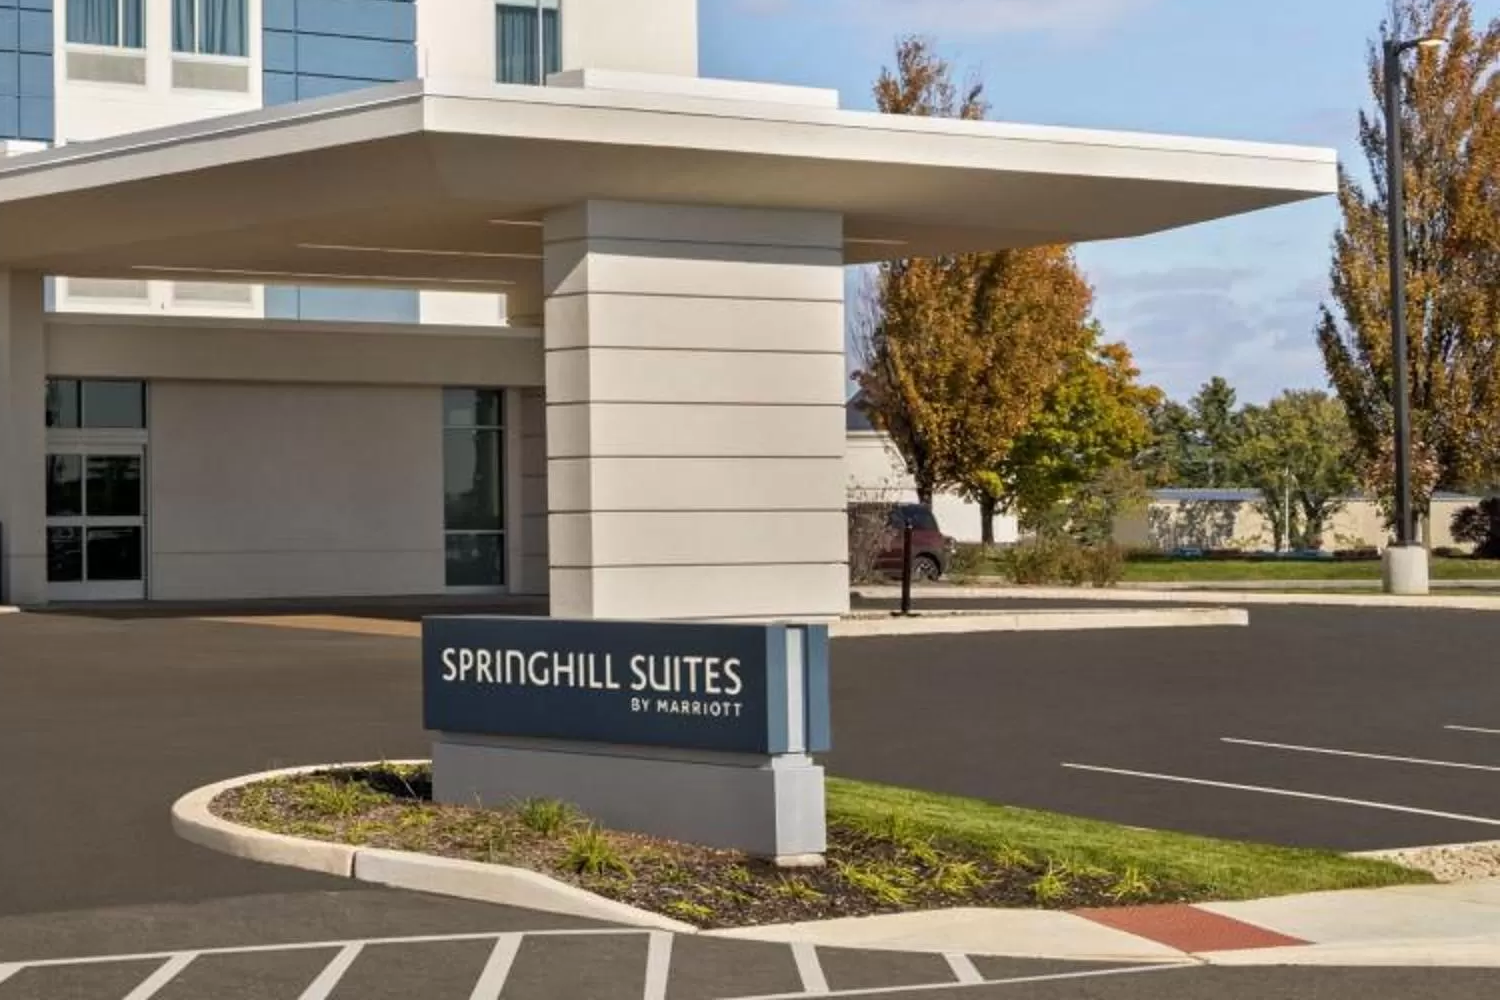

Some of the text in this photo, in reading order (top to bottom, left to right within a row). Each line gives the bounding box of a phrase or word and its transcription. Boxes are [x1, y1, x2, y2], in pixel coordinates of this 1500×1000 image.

[441, 647, 743, 696] SPRINGHILL SUITES
[630, 696, 744, 718] BY MARRIOTT
